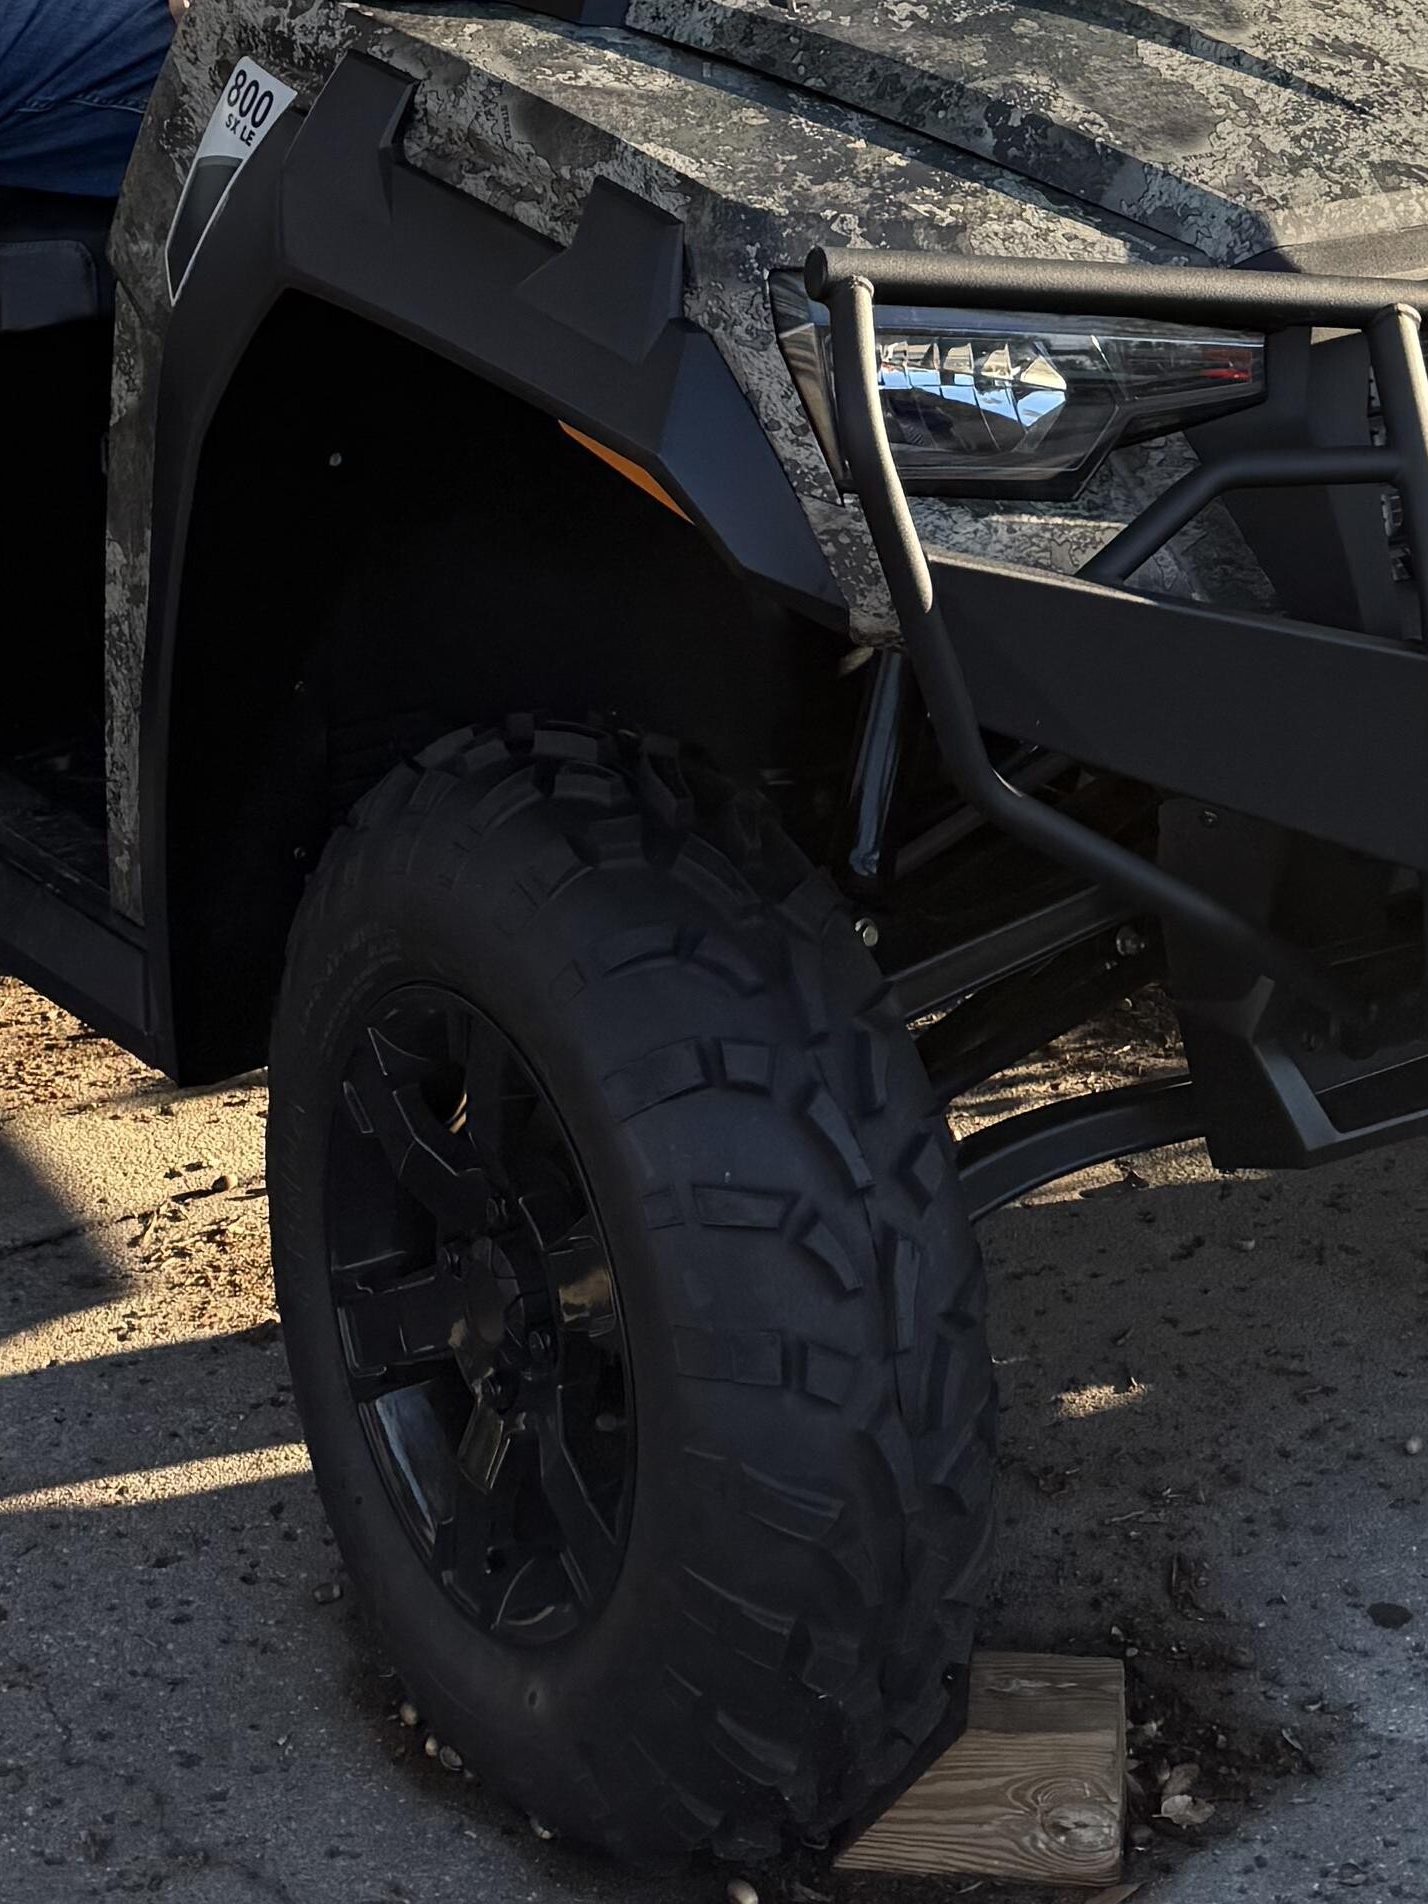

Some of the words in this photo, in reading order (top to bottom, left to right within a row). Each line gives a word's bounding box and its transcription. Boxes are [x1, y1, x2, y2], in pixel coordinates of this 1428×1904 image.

[227, 68, 274, 129] 800
[225, 112, 241, 135] SX
[239, 125, 256, 147] LE
